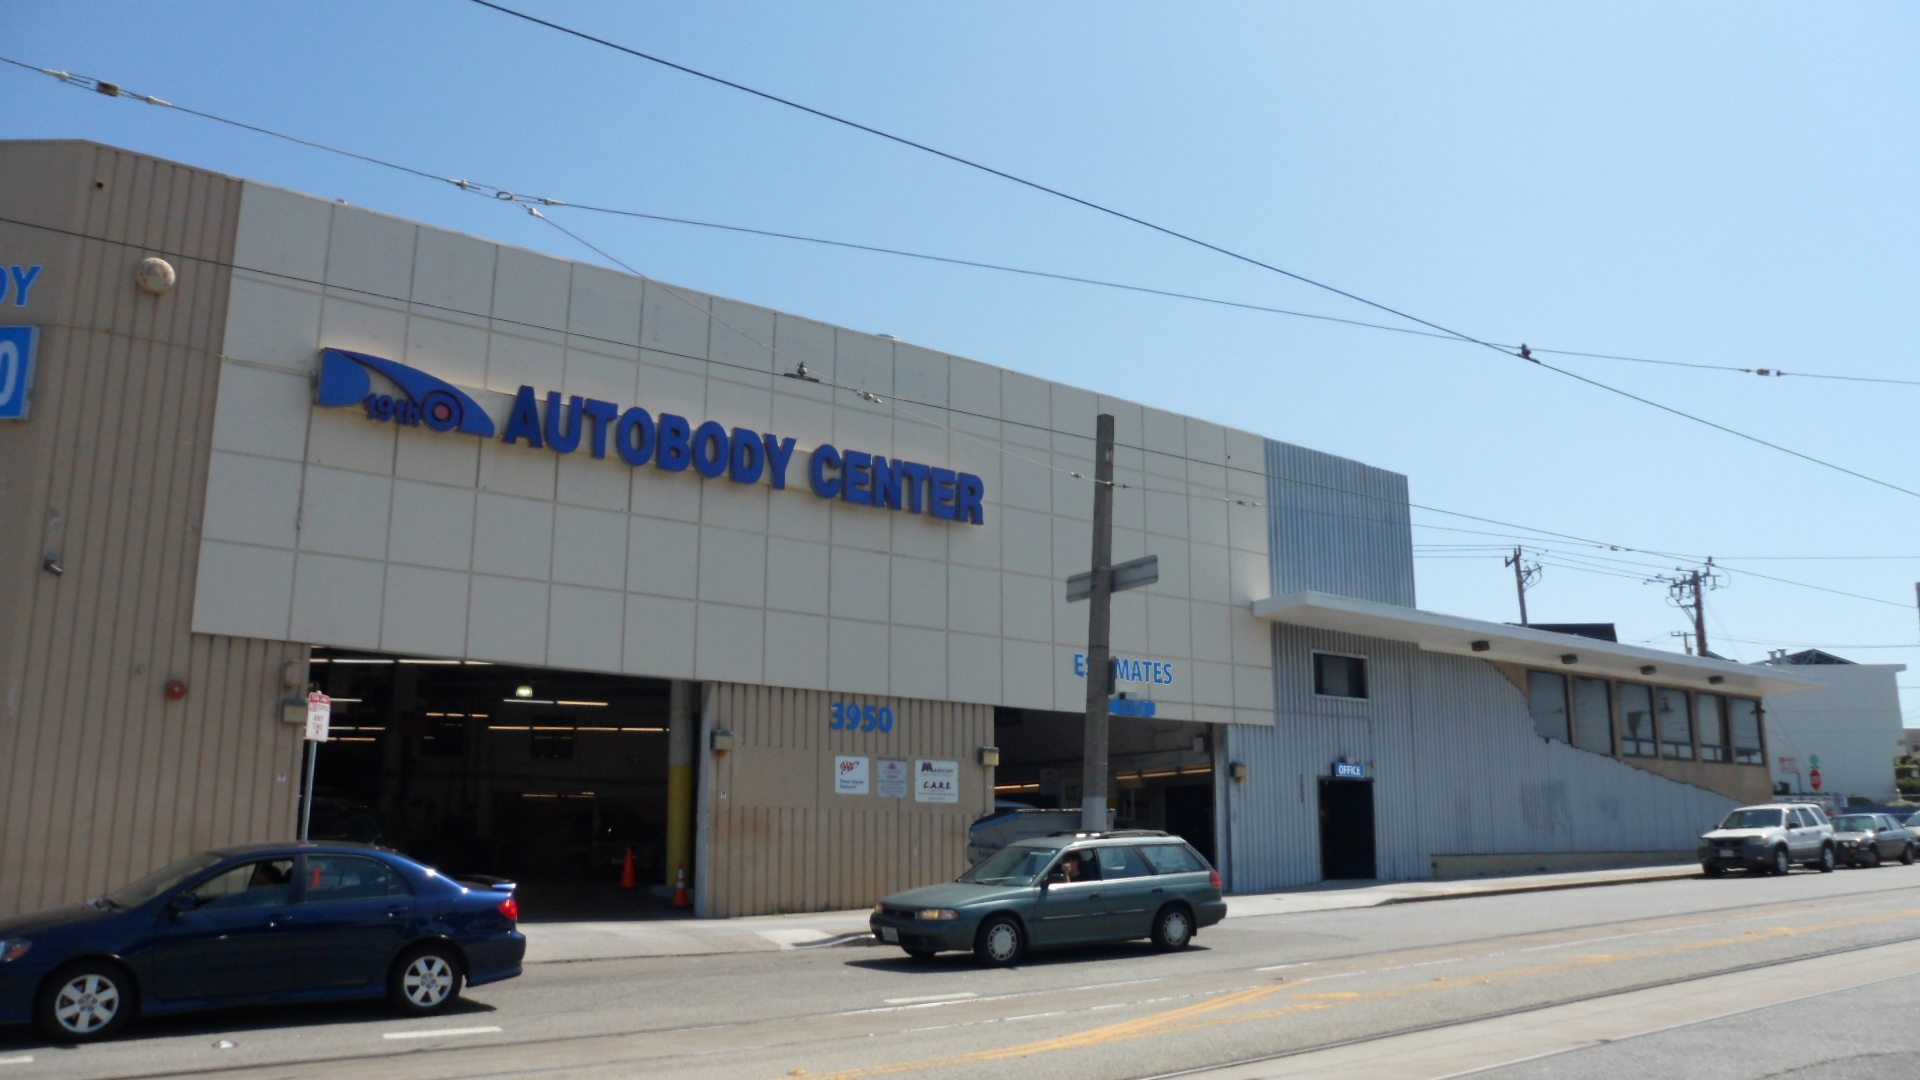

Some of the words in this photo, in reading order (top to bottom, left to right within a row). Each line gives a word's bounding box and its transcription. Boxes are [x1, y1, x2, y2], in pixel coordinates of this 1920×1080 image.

[363, 393, 421, 427] 19th
[502, 384, 797, 490] AUTOBODY
[809, 443, 984, 526] CENTER
[1073, 653, 1173, 686] EMATES
[829, 702, 894, 733] 3950
[1338, 764, 1362, 776] OFFICE
